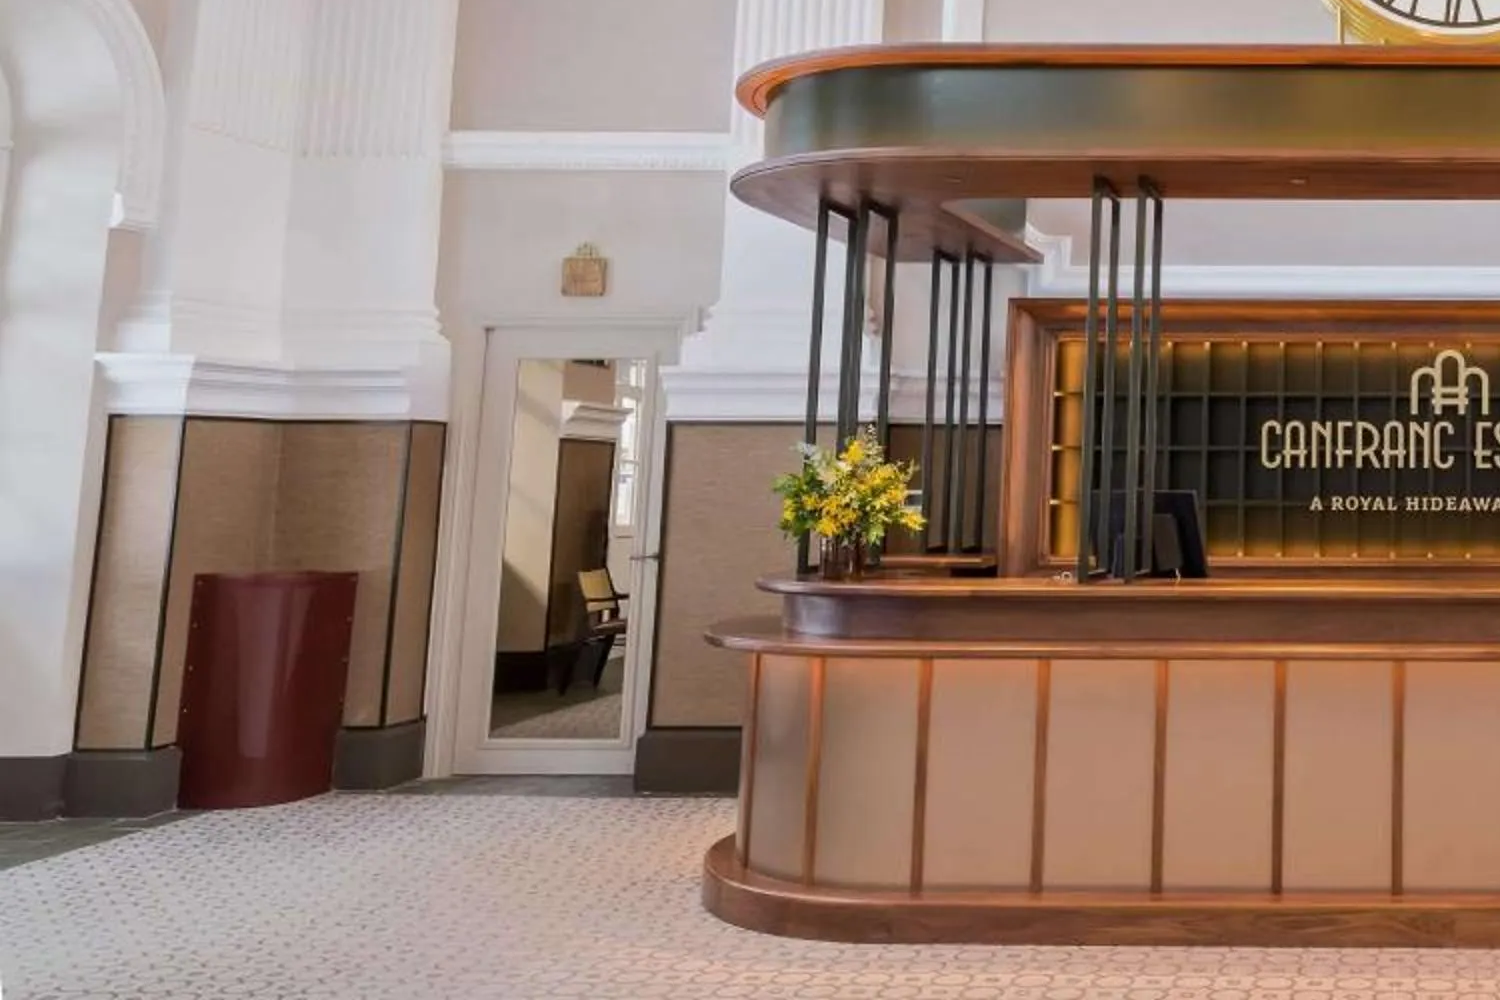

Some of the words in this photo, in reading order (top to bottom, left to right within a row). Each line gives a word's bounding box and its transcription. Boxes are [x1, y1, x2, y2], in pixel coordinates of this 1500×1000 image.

[1261, 420, 1455, 469] CANFRANC
[1309, 496, 1323, 511] A
[1330, 496, 1398, 511] ROYAL
